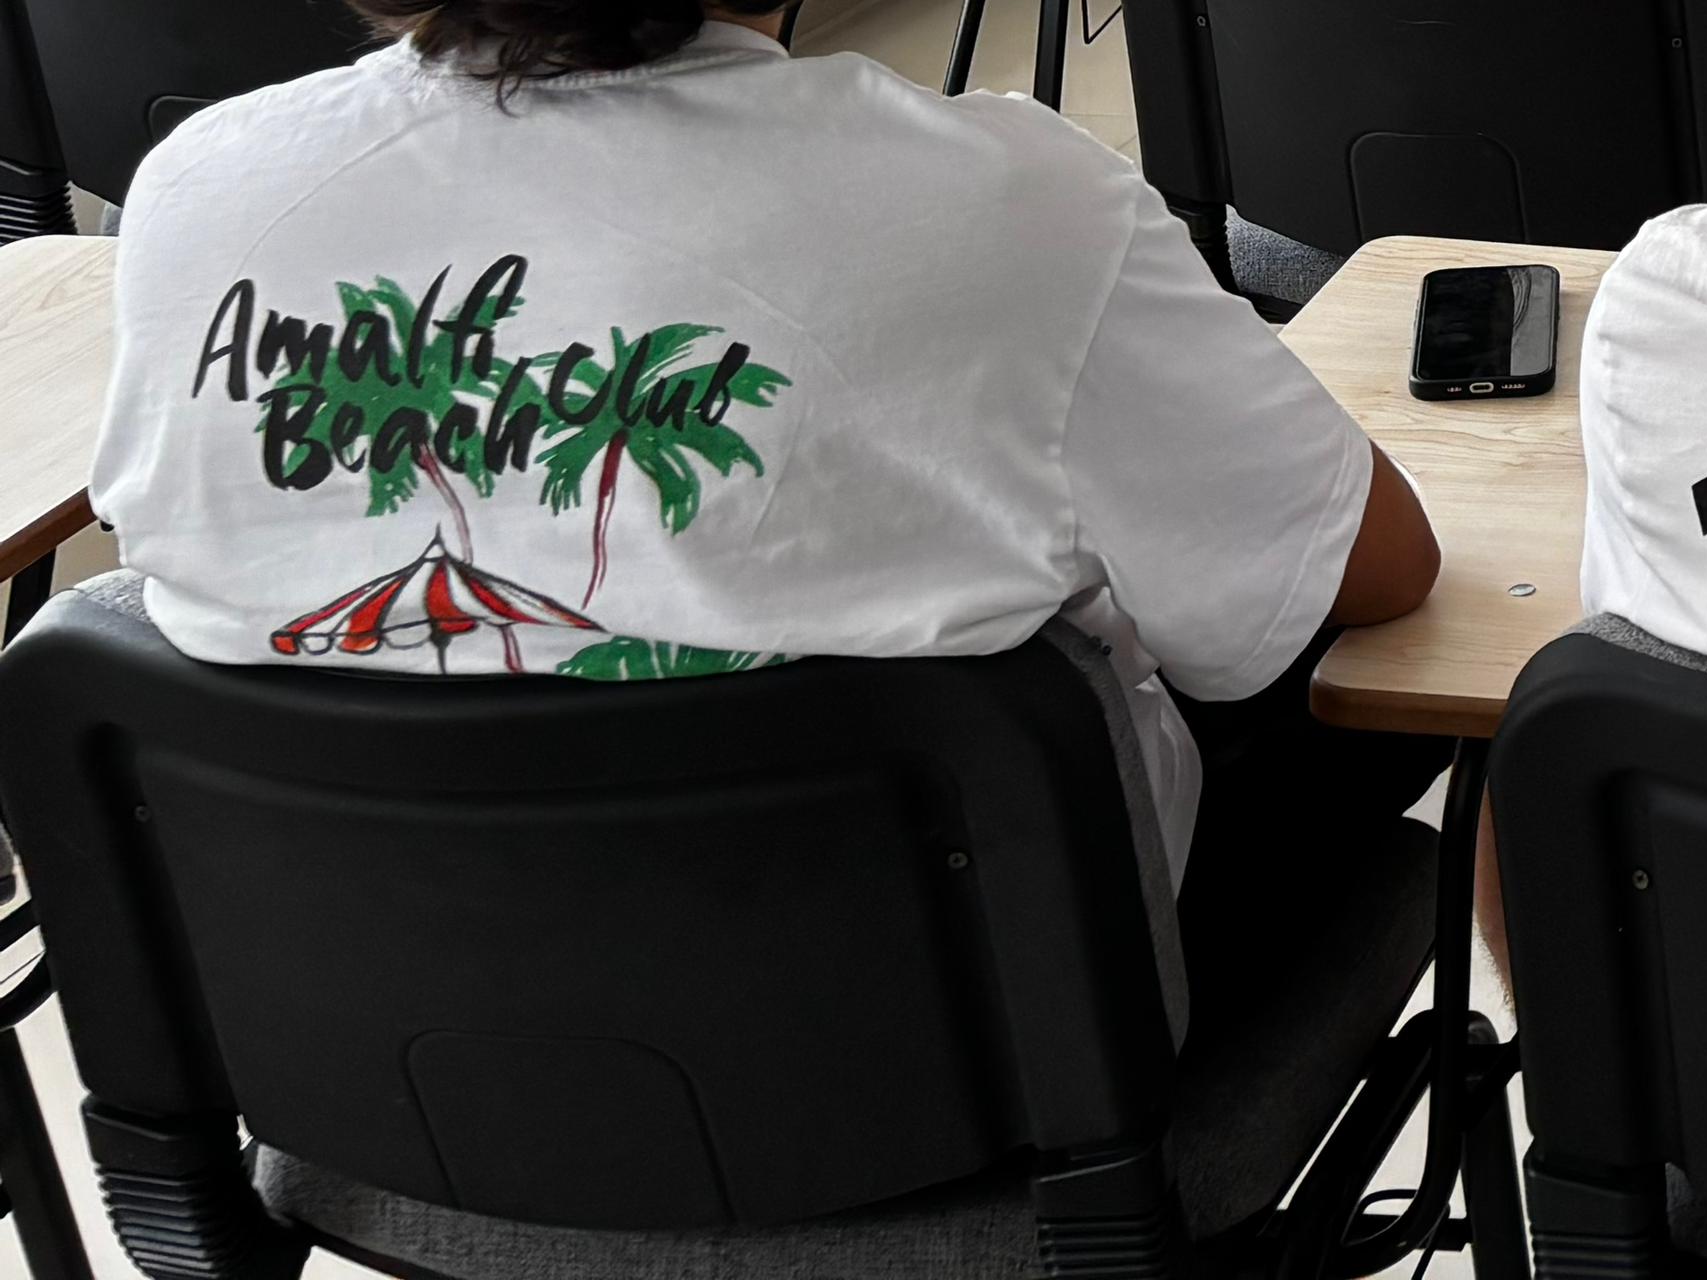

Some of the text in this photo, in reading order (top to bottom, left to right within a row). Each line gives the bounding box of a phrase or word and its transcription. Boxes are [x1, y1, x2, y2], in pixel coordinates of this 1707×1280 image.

[192, 253, 528, 402] Amalfi
[256, 332, 751, 491] Beach Club
